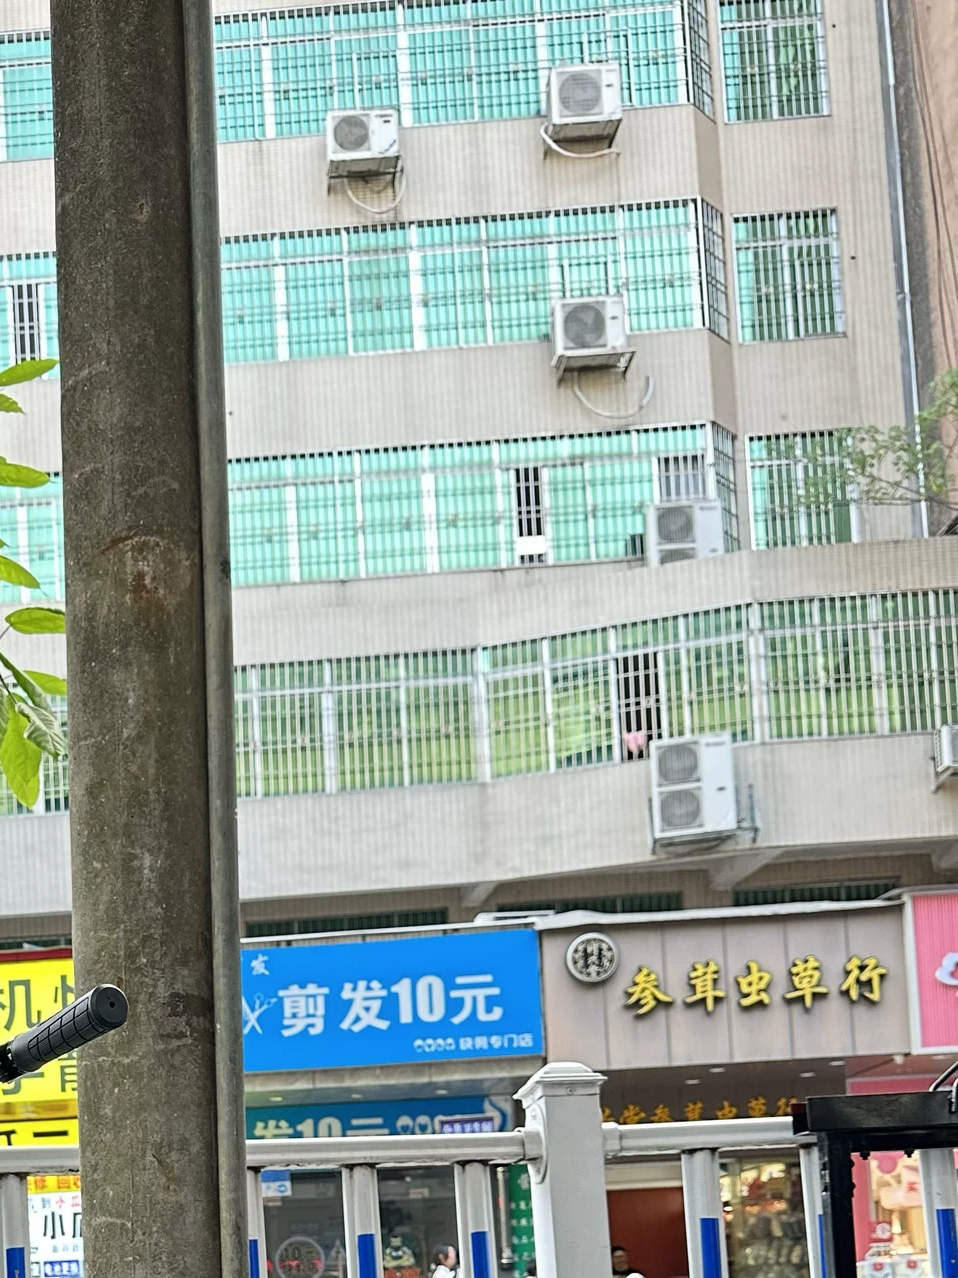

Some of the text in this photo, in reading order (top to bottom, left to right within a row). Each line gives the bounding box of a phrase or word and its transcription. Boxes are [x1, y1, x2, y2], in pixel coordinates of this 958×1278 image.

[278, 975, 504, 1038] 剪发10元
[624, 955, 889, 1016] 参茸虫草行
